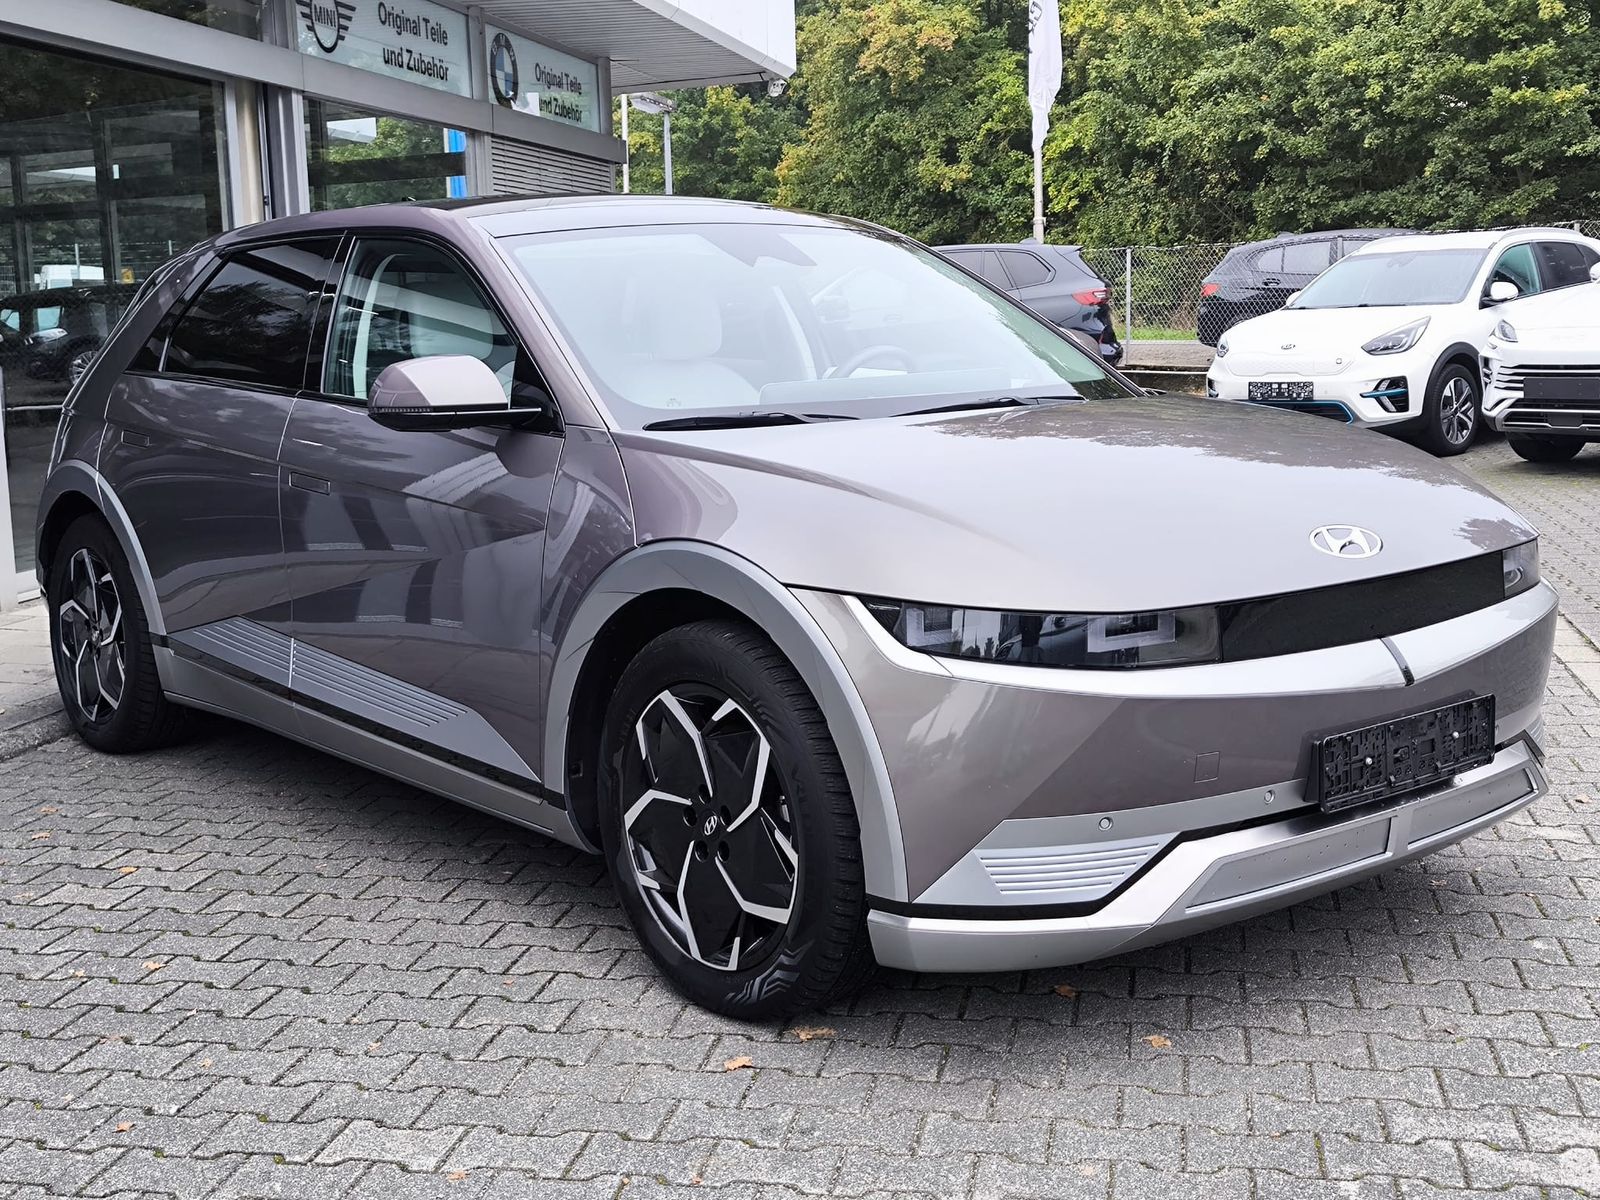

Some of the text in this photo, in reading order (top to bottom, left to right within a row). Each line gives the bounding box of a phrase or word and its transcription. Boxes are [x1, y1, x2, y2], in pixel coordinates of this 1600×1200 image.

[313, 4, 337, 28] MINI
[378, 1, 448, 46] Original Teile
[383, 47, 449, 81] und Zubehör
[535, 62, 582, 95] Original Teile
[553, 97, 582, 122] Zubehör
